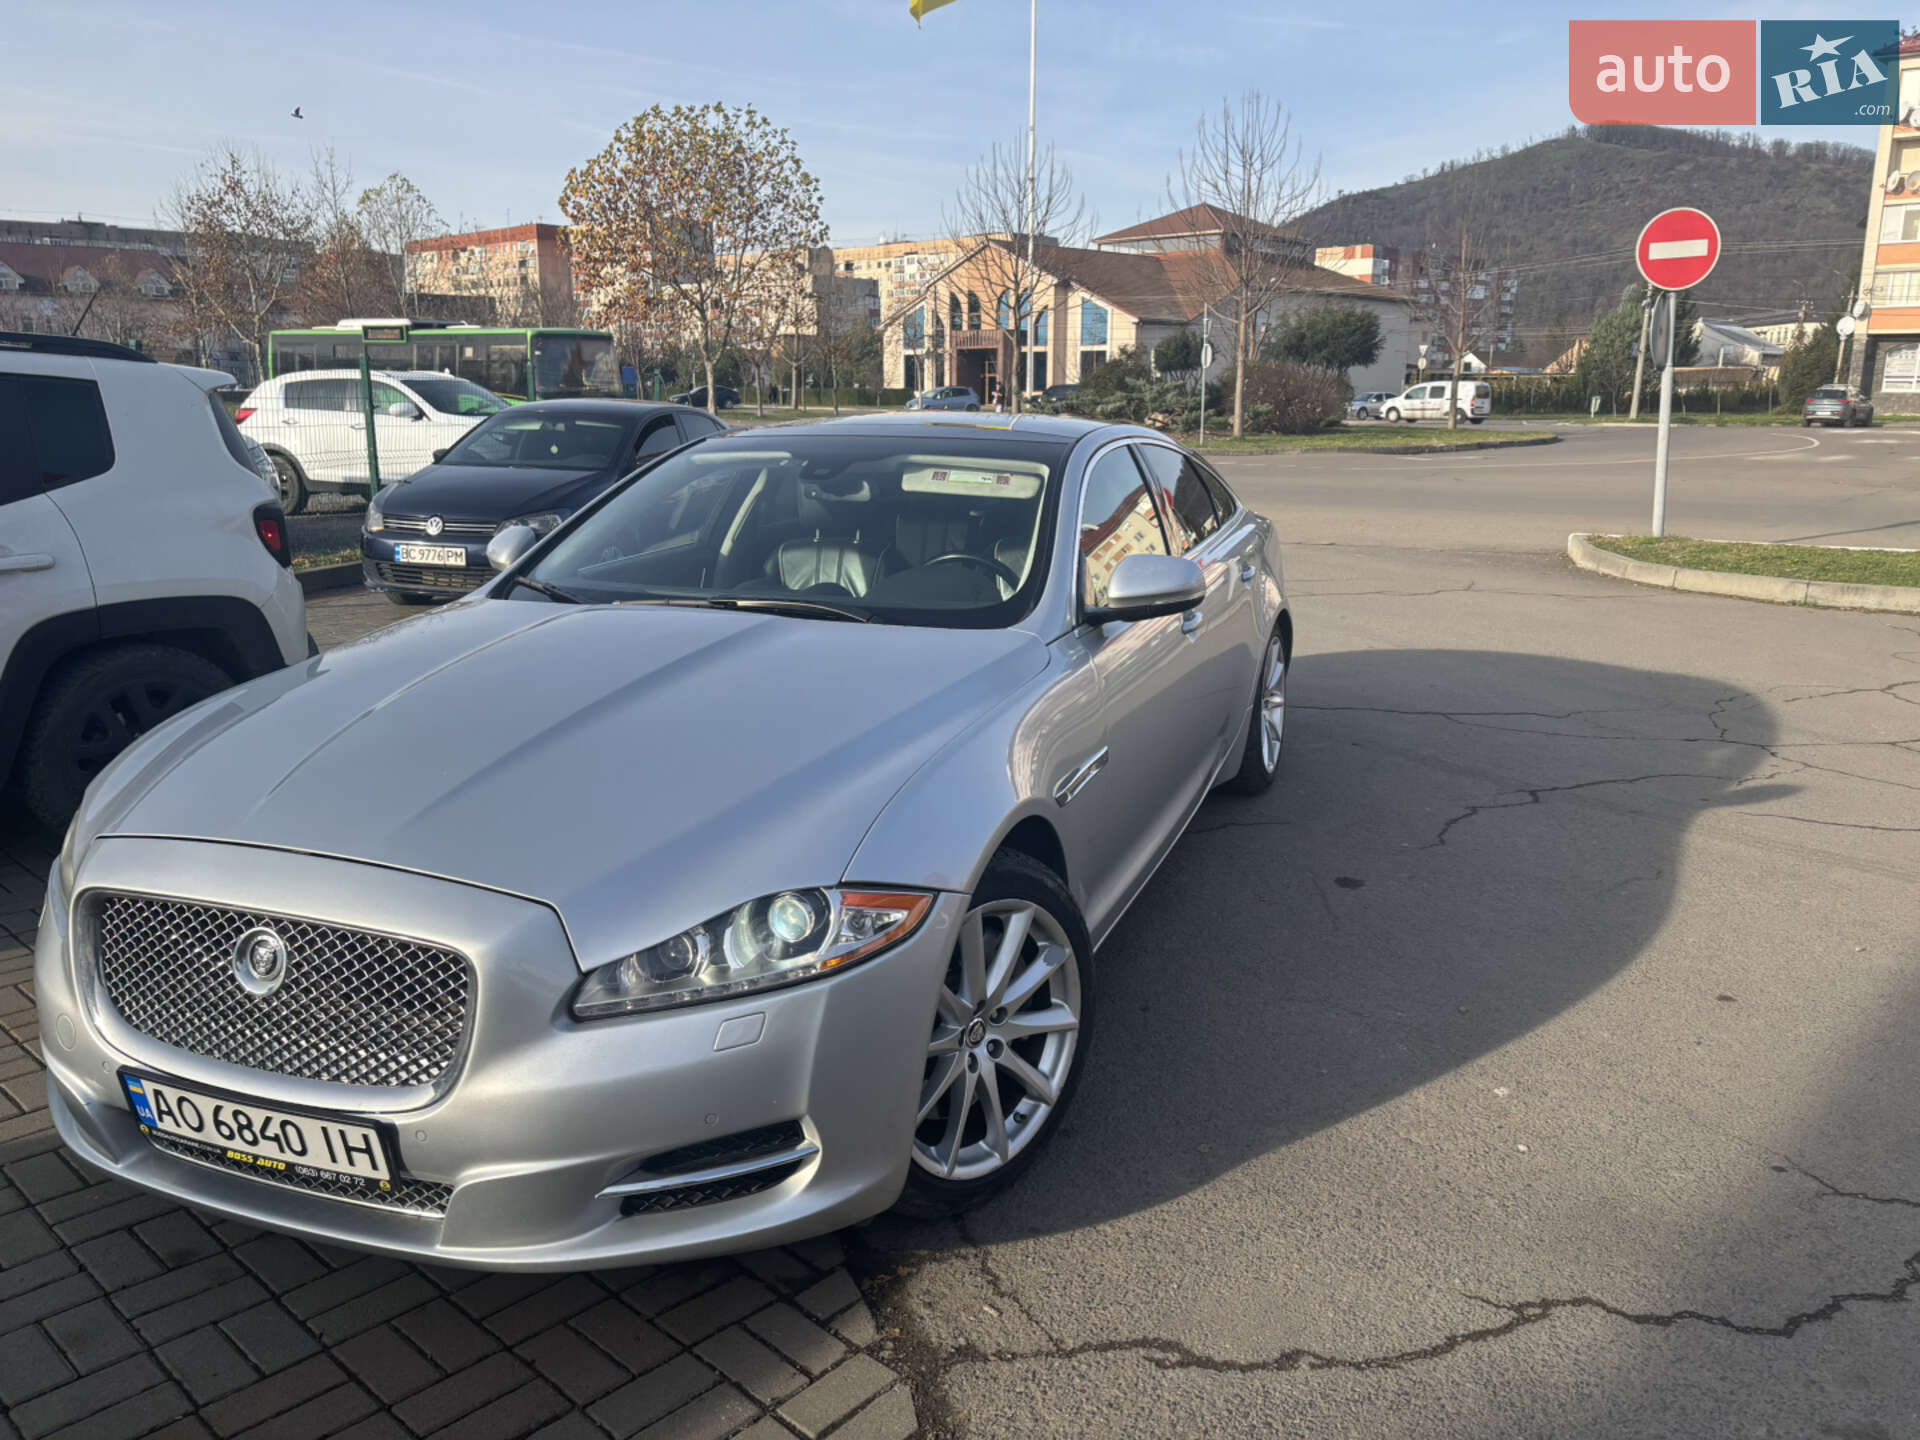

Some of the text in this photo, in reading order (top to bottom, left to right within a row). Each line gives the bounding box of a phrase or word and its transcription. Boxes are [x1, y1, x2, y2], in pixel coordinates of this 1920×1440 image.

[401, 547, 464, 563] BC 9776 PM
[136, 1105, 154, 1119] UA
[152, 1088, 204, 1133] AO
[212, 1104, 308, 1157] 6840
[321, 1126, 379, 1171] IH
[226, 1150, 254, 1164] BOSS
[256, 1157, 287, 1171] AUTO
